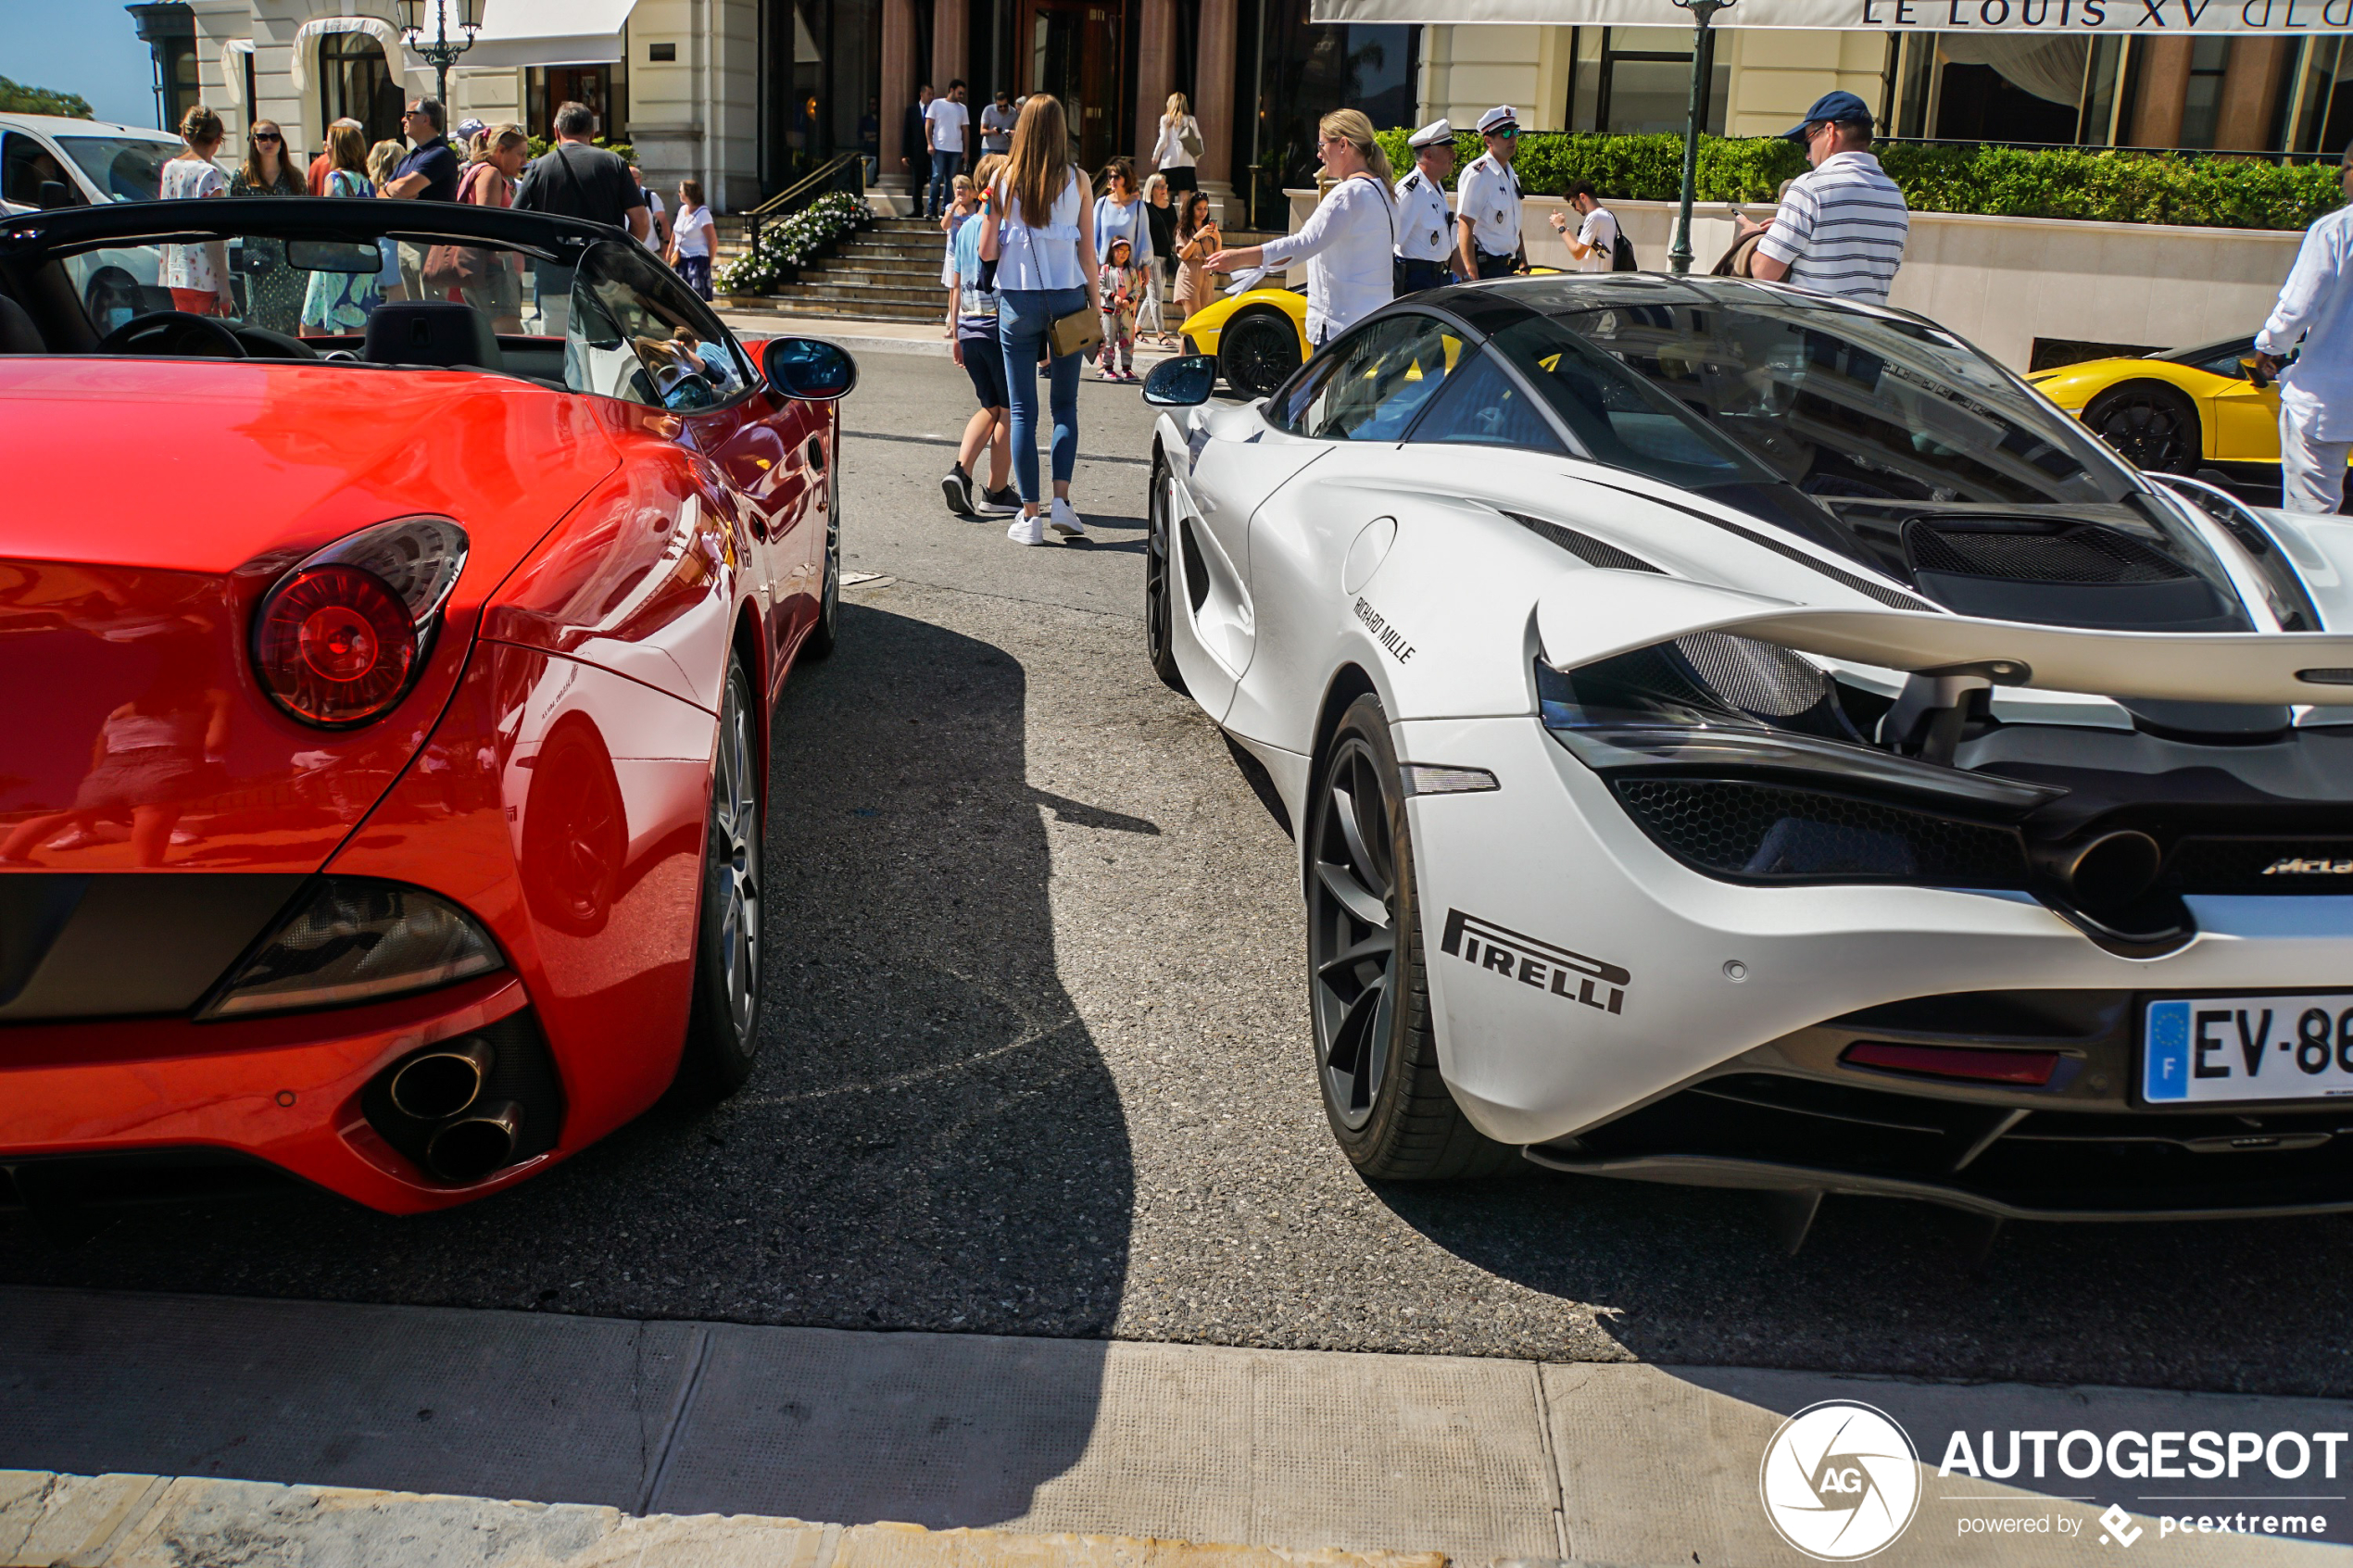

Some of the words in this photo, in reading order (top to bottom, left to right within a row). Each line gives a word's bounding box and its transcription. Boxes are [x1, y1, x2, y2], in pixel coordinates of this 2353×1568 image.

[1863, 0, 1917, 24] LE
[1948, 0, 2107, 27] LOUIS
[2136, 0, 2209, 27] XV
[1353, 596, 1385, 634] RICHARD
[1378, 624, 1416, 665] MILLE
[1441, 907, 1631, 1015] PIRELLI
[2162, 1057, 2176, 1080] F
